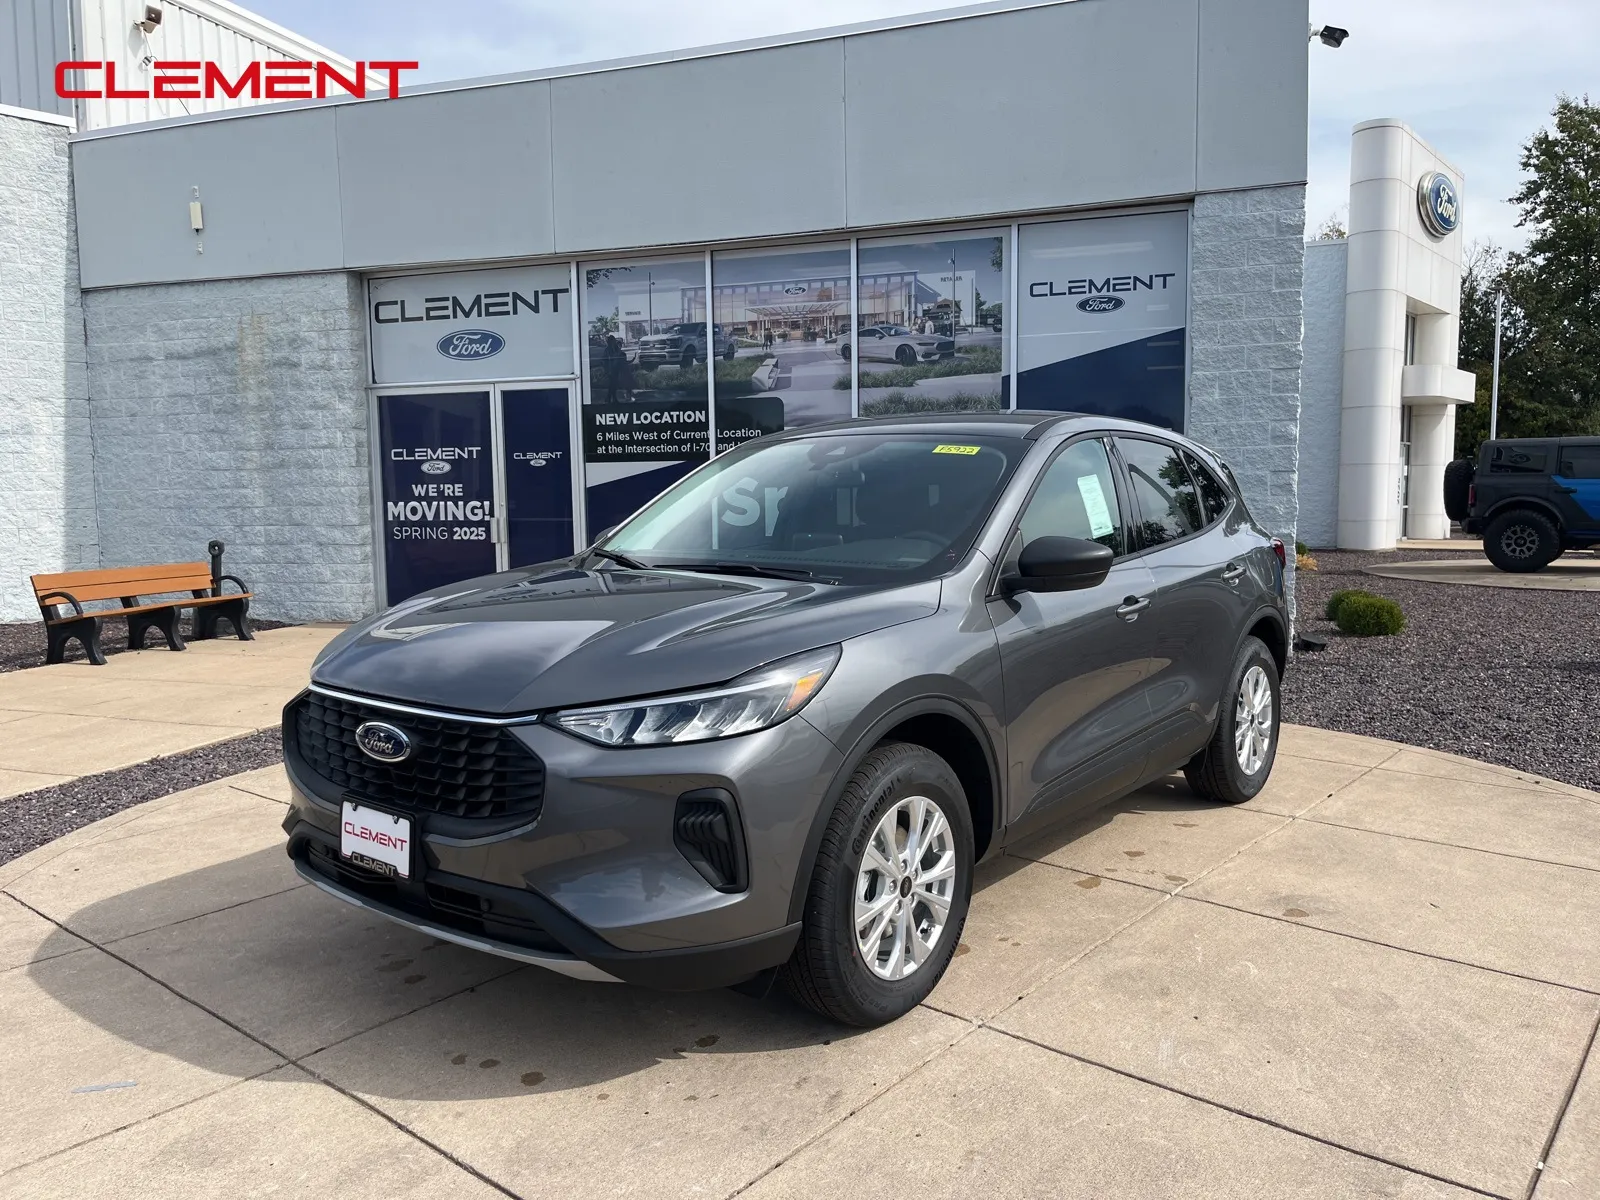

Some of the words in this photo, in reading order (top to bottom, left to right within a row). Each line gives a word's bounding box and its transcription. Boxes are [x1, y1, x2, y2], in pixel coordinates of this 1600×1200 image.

[1437, 184, 1457, 223] Ford
[1029, 272, 1176, 298] CLEMENT
[374, 288, 570, 325] CLEMENT
[1085, 297, 1116, 311] Ford
[449, 333, 493, 356] Ford
[595, 412, 629, 426] NEW
[632, 410, 706, 425] LOCATION
[596, 432, 603, 442] 6
[605, 431, 630, 442] Miles
[632, 430, 658, 441] West
[660, 430, 671, 440] of
[673, 429, 711, 440] Current
[717, 427, 762, 439] Location
[390, 447, 481, 461] CLEMENT
[513, 451, 563, 460] CLEMENT
[597, 446, 607, 455] at
[607, 444, 624, 454] the
[625, 442, 680, 454] Intersection
[681, 442, 691, 452] of
[411, 483, 464, 497] WE'RE
[387, 500, 491, 522] MOVING!
[393, 526, 448, 541] SPRING
[453, 526, 486, 541] 2025
[365, 728, 395, 754] Ford
[344, 821, 408, 852] CLEMENT
[352, 852, 396, 878] CLEMENT
